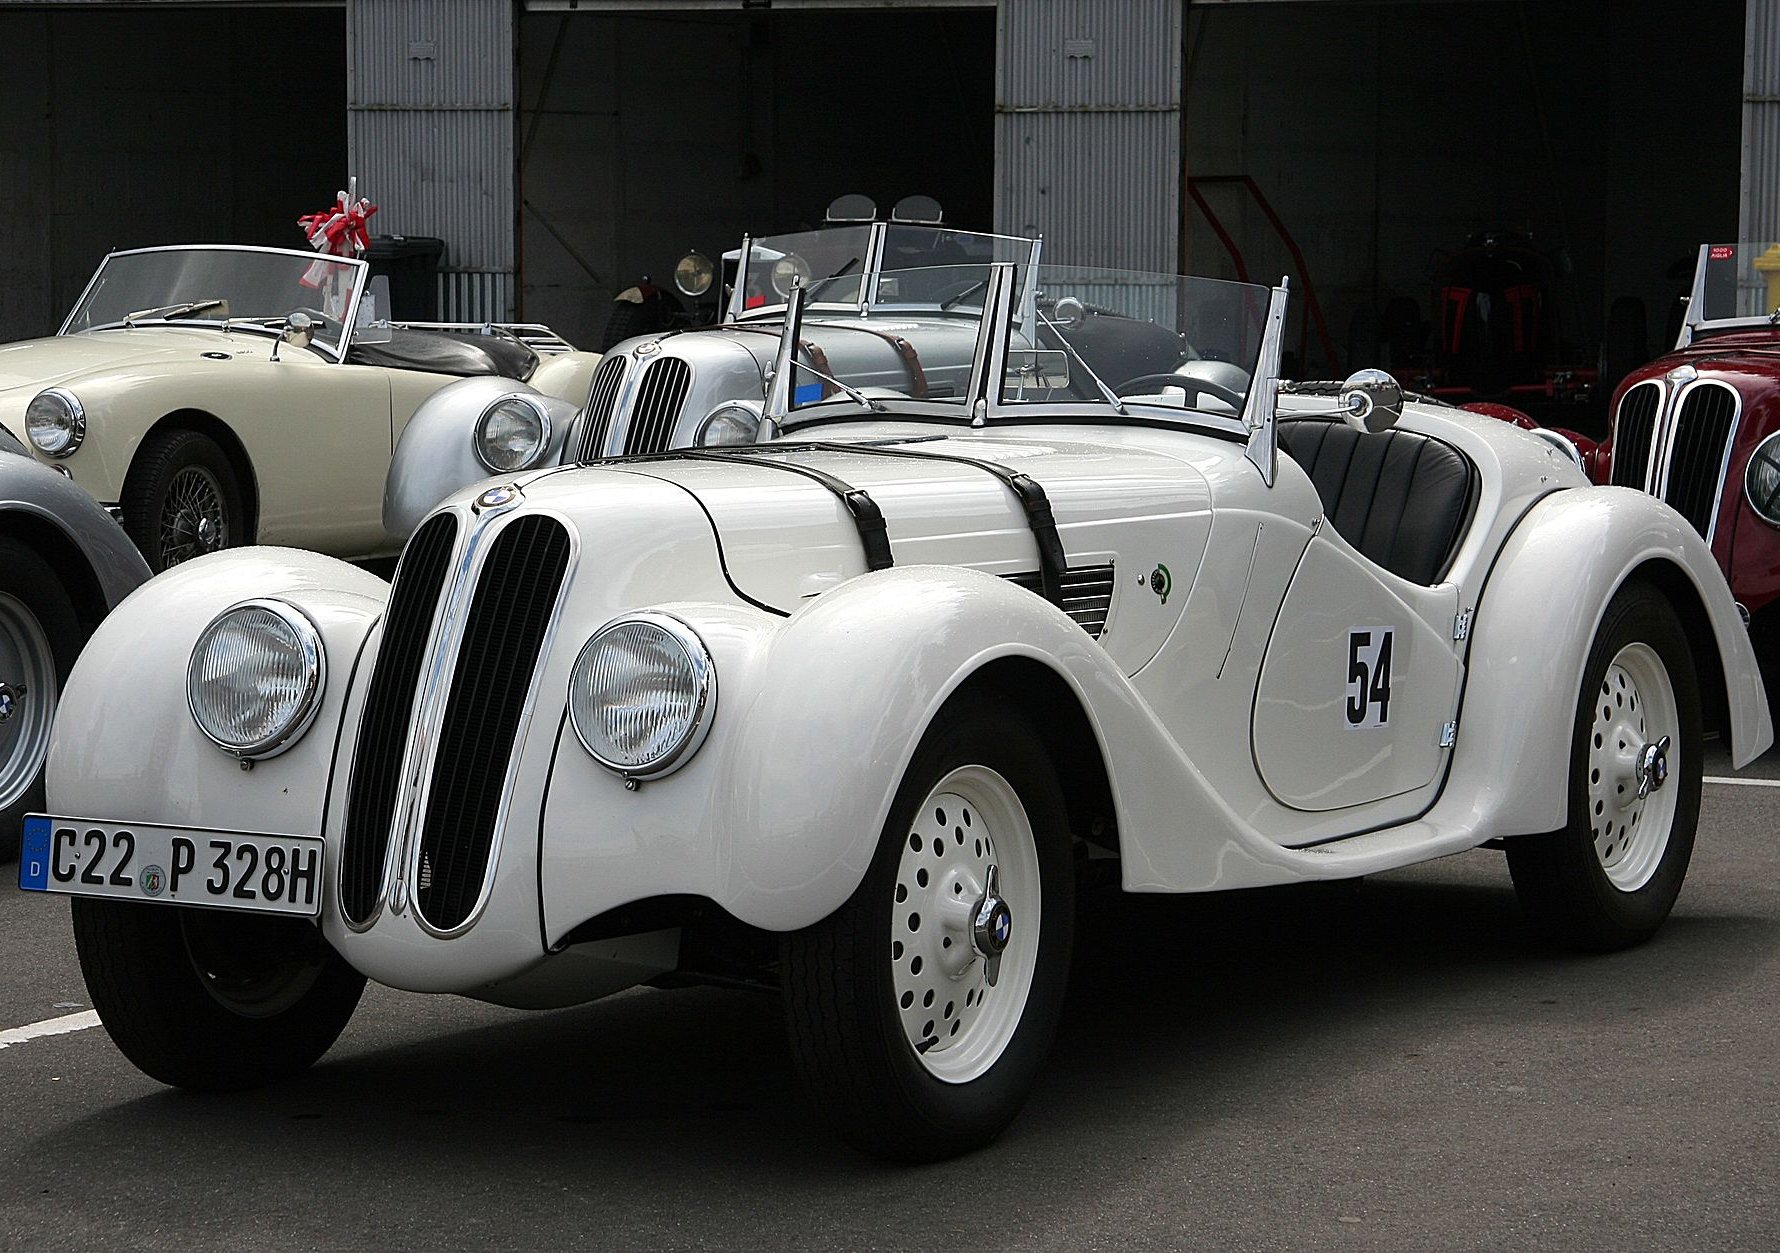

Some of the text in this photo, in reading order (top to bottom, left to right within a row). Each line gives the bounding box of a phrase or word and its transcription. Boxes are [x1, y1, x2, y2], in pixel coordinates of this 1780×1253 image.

[1346, 631, 1393, 724] 54
[30, 862, 40, 877] D
[52, 828, 136, 887] C22
[169, 836, 196, 892] P
[206, 840, 318, 904] 328H
